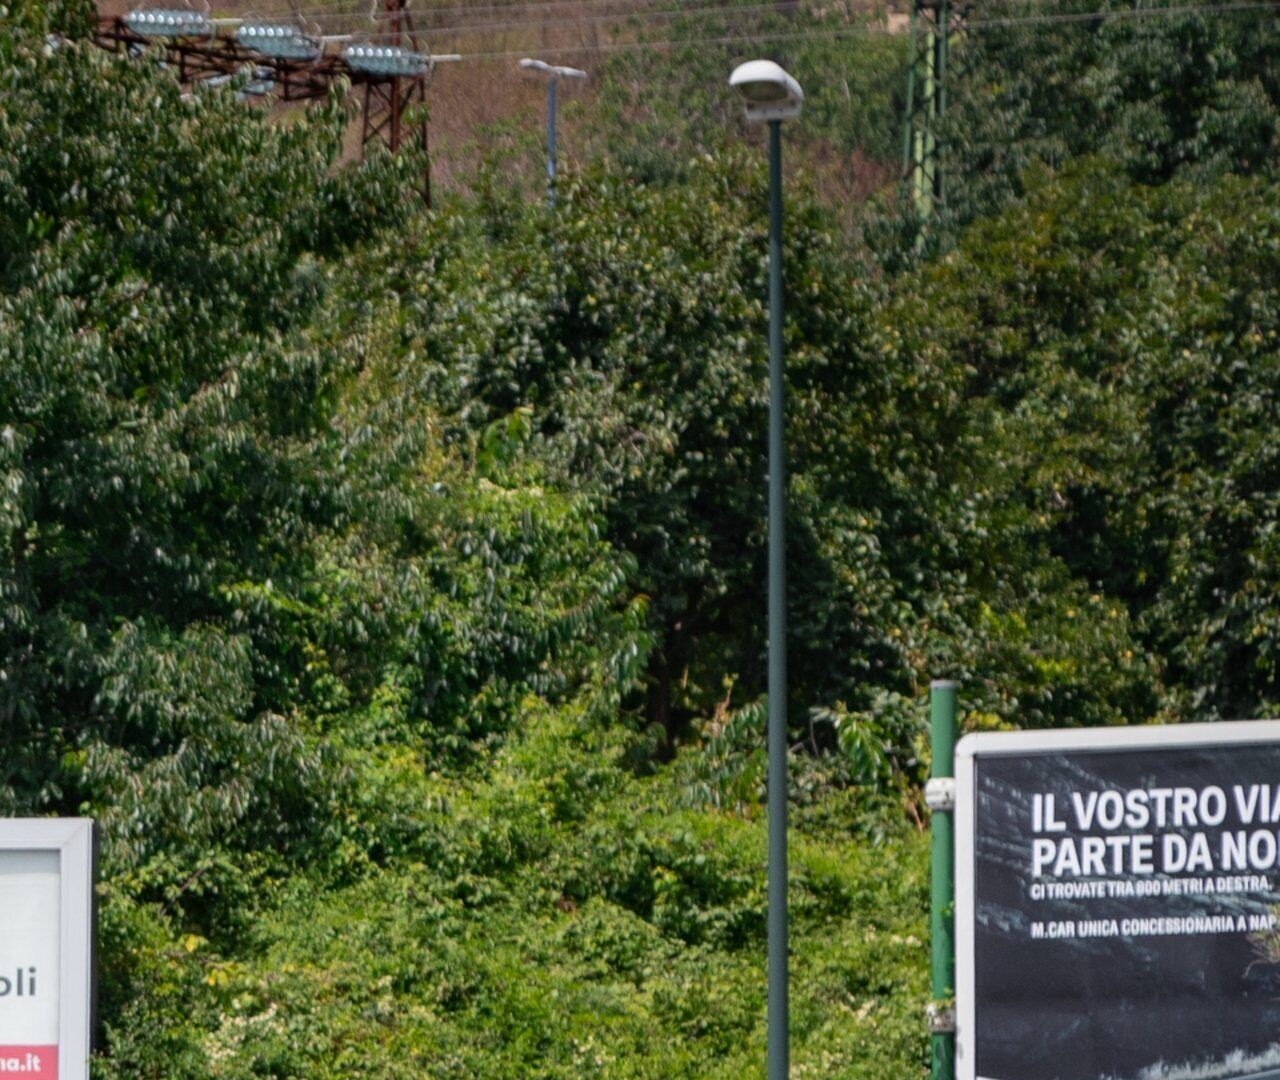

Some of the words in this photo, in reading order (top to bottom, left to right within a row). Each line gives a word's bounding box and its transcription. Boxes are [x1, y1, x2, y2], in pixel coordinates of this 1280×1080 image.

[1032, 792, 1067, 833] IL
[1072, 785, 1228, 832] VOSTRO
[1032, 834, 1155, 878] PARTE
[1162, 832, 1214, 873] DA
[1221, 829, 1280, 871] NO
[1030, 883, 1046, 900] CI
[1047, 881, 1106, 899] TROVATE
[1106, 881, 1134, 897] TRA
[1162, 877, 1203, 895] METRI
[1204, 877, 1215, 894] A
[1031, 920, 1075, 939] M.CAR
[1078, 919, 1119, 937] UNICA
[1121, 915, 1235, 936] CONCESSIONARIA
[1236, 915, 1248, 932] A
